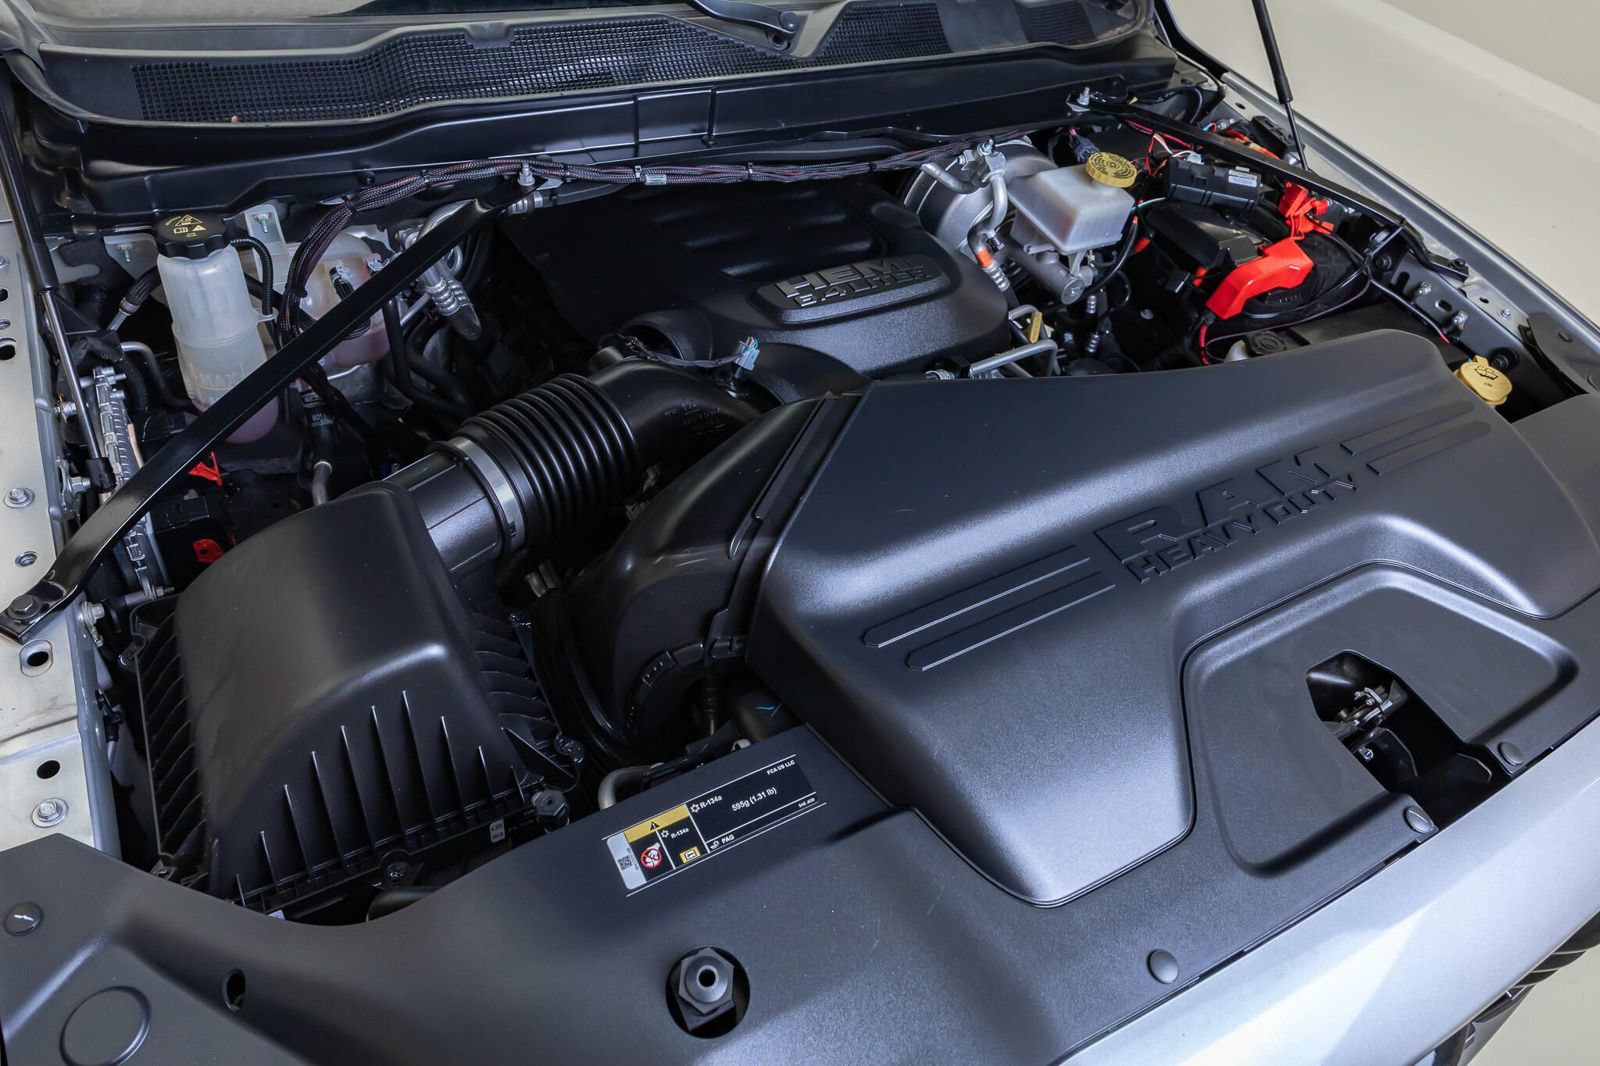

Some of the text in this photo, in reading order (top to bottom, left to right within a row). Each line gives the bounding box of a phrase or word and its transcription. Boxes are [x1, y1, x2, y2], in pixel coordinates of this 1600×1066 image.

[775, 257, 914, 298] HEMI
[1093, 444, 1354, 563] RAM
[1125, 472, 1359, 583] HEAVY DUTY
[699, 795, 723, 809] R-134a
[731, 787, 777, 811] 595g (1.31 lb)
[721, 834, 735, 844] PAG
